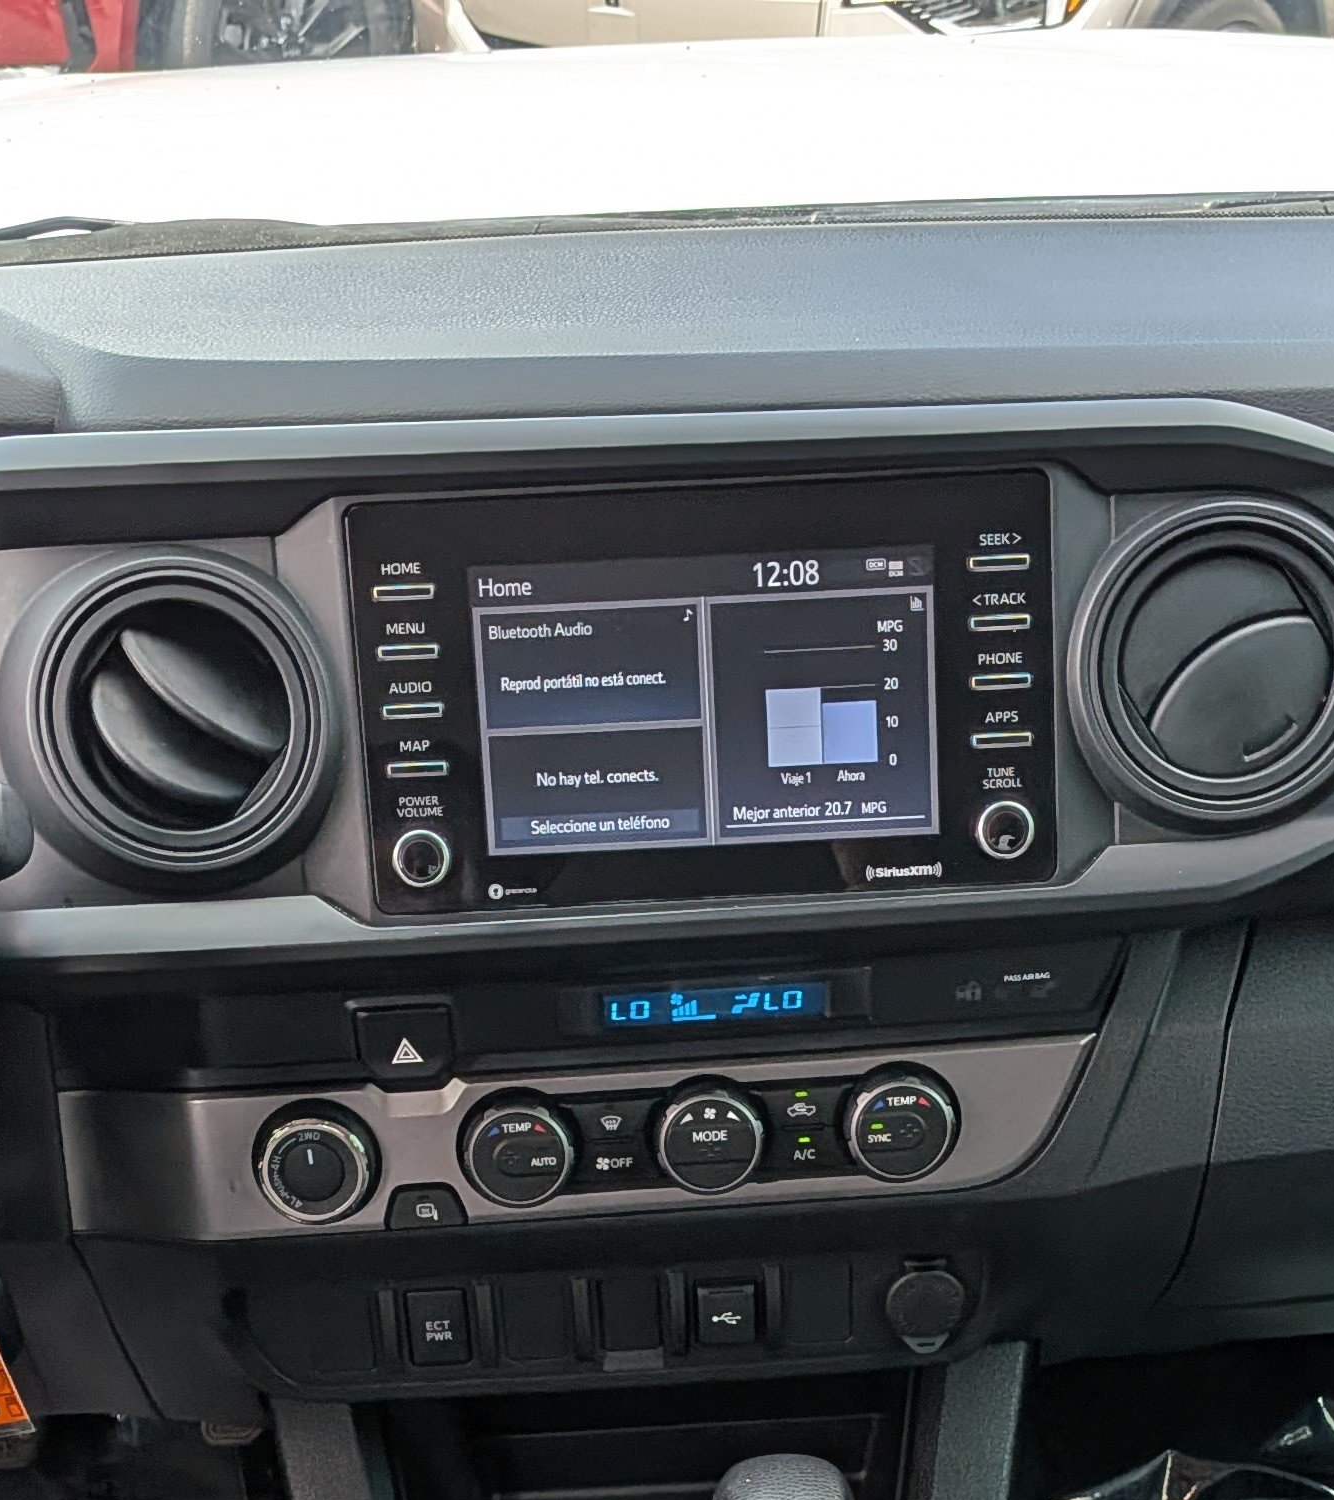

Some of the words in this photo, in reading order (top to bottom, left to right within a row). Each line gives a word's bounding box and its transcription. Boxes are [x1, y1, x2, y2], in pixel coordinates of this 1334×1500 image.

[380, 561, 421, 575] HOME
[752, 559, 820, 588] 12:08
[478, 578, 533, 598] Home
[385, 621, 426, 635] MENU
[488, 623, 551, 640] Bluetooth
[554, 621, 593, 637] Audio
[876, 620, 904, 633] MPG
[882, 638, 898, 651] 30
[977, 651, 1023, 666] PHONE
[388, 681, 432, 694] AUDIO
[500, 675, 541, 694] Reprod
[543, 673, 583, 693] portátil
[585, 675, 599, 688] no
[601, 671, 624, 687] está
[626, 671, 667, 685] conect.
[883, 677, 899, 690] 20
[885, 715, 899, 728] 10
[984, 710, 1019, 724] APPS
[399, 739, 430, 752] MAP
[888, 753, 898, 766] 0
[836, 769, 866, 782] Ahora
[987, 766, 1015, 777] TUNE
[536, 772, 557, 787] No
[559, 771, 581, 788] hay
[583, 770, 604, 785] tel.
[606, 769, 660, 784] conects.
[780, 772, 805, 786] Viaje
[982, 777, 1022, 790] SCROLL
[398, 795, 439, 806] POWER
[396, 806, 444, 818] VOLUME
[732, 806, 771, 823] Mejor
[772, 803, 821, 819] anterior
[824, 801, 853, 816] 20.7
[861, 801, 887, 814] MPG
[530, 819, 597, 836] Seleccione
[599, 820, 615, 832] un
[617, 814, 671, 831] teléfono
[1003, 974, 1022, 982] PASS
[764, 990, 803, 1011] LO
[611, 1000, 650, 1021] LO
[886, 1096, 917, 1107] TEMP
[501, 1122, 532, 1133] TEMP
[296, 1131, 321, 1143] 2WD
[692, 1130, 728, 1143] MODE
[867, 1132, 892, 1144] SYNC
[793, 1148, 816, 1161] A/C
[530, 1156, 557, 1167] AUTO
[610, 1156, 634, 1169] OFF
[425, 1319, 450, 1331] ECT
[425, 1330, 453, 1342] PWR
